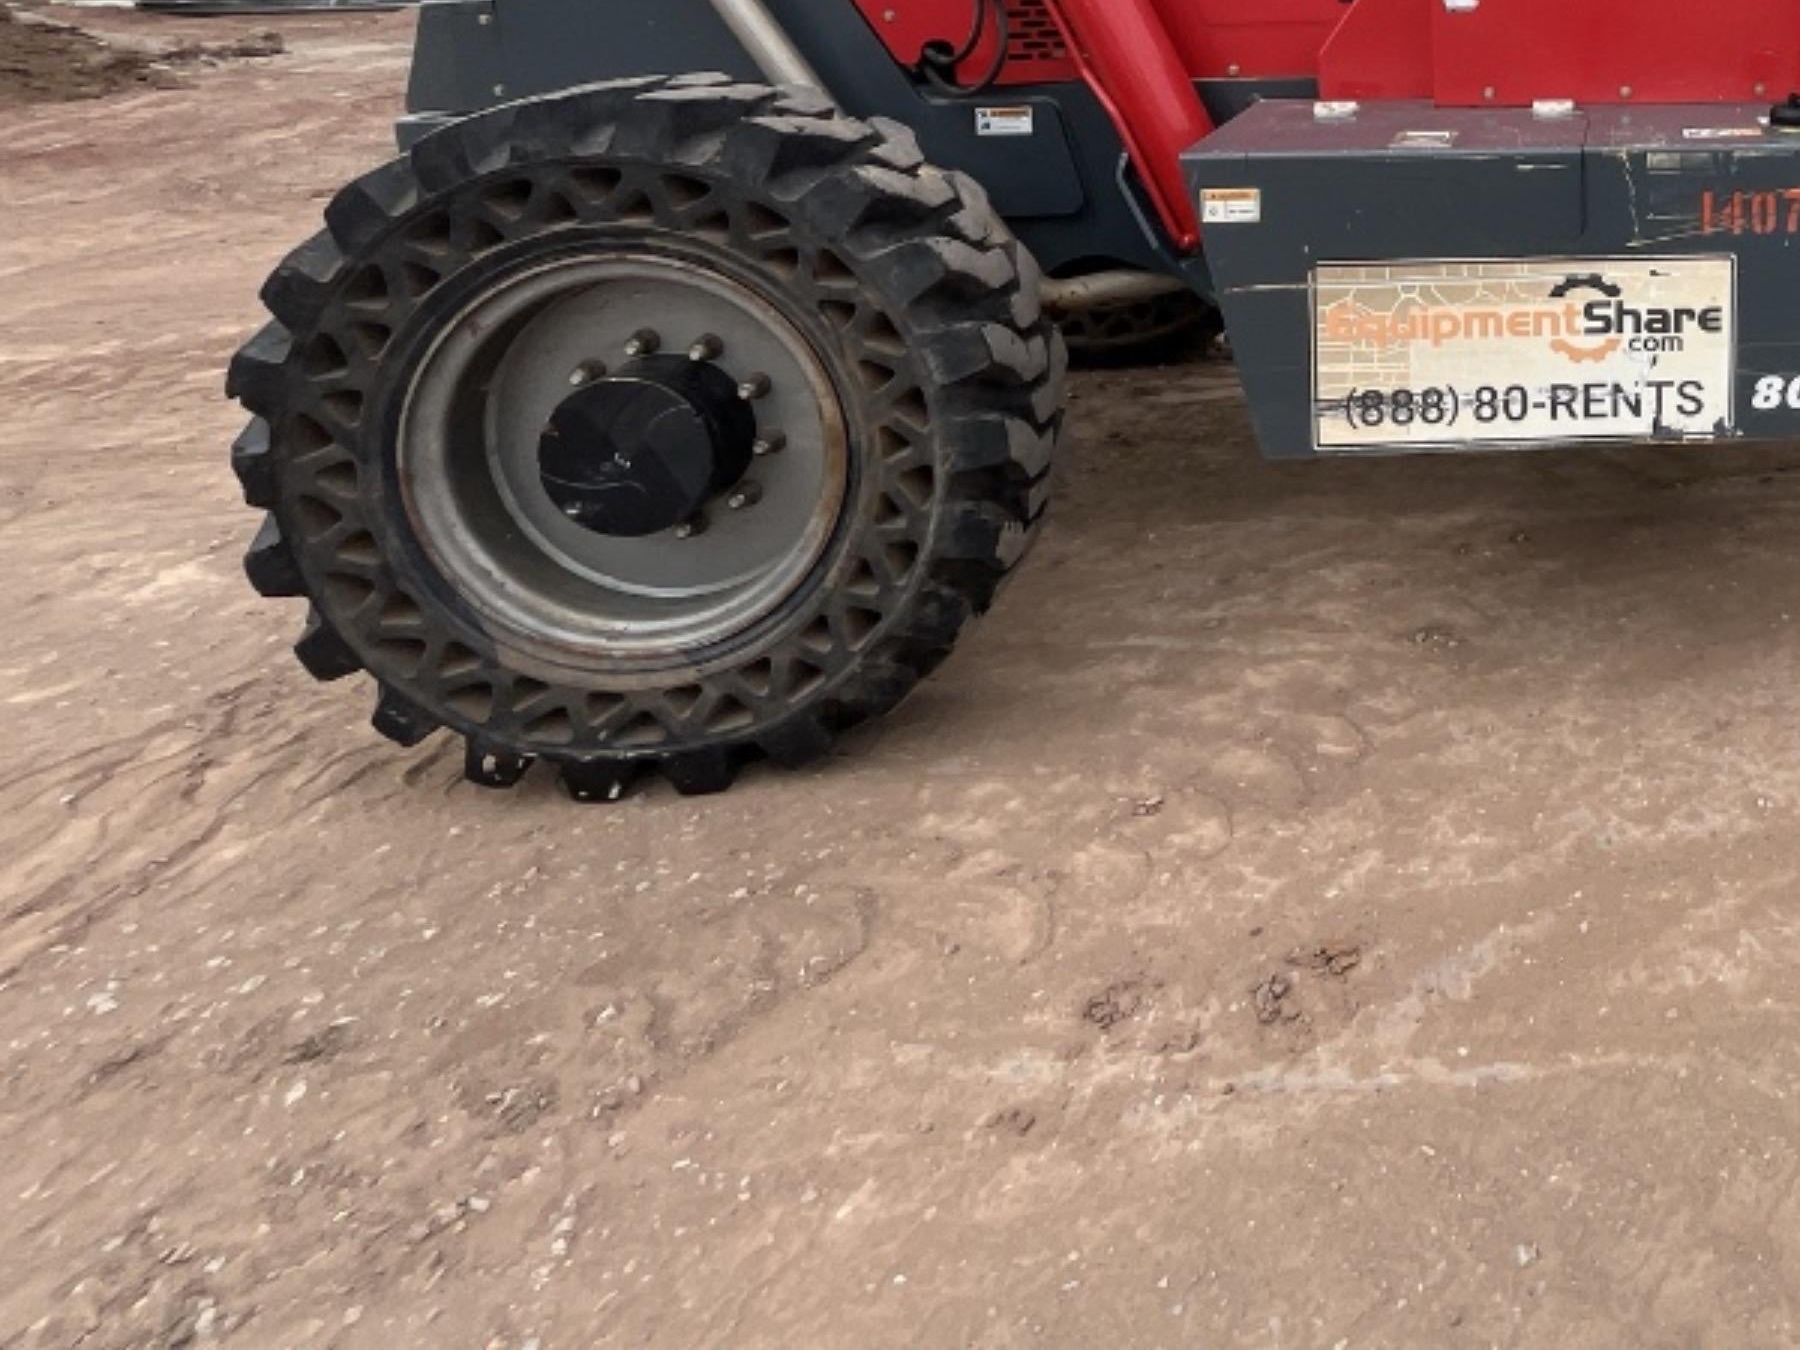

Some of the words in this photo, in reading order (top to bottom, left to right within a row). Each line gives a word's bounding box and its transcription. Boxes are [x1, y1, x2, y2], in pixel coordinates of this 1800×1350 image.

[1326, 301, 1723, 347] EquipmentShare
[1346, 386, 1460, 429] (888)
[1473, 380, 1706, 423] 80-RENTS
